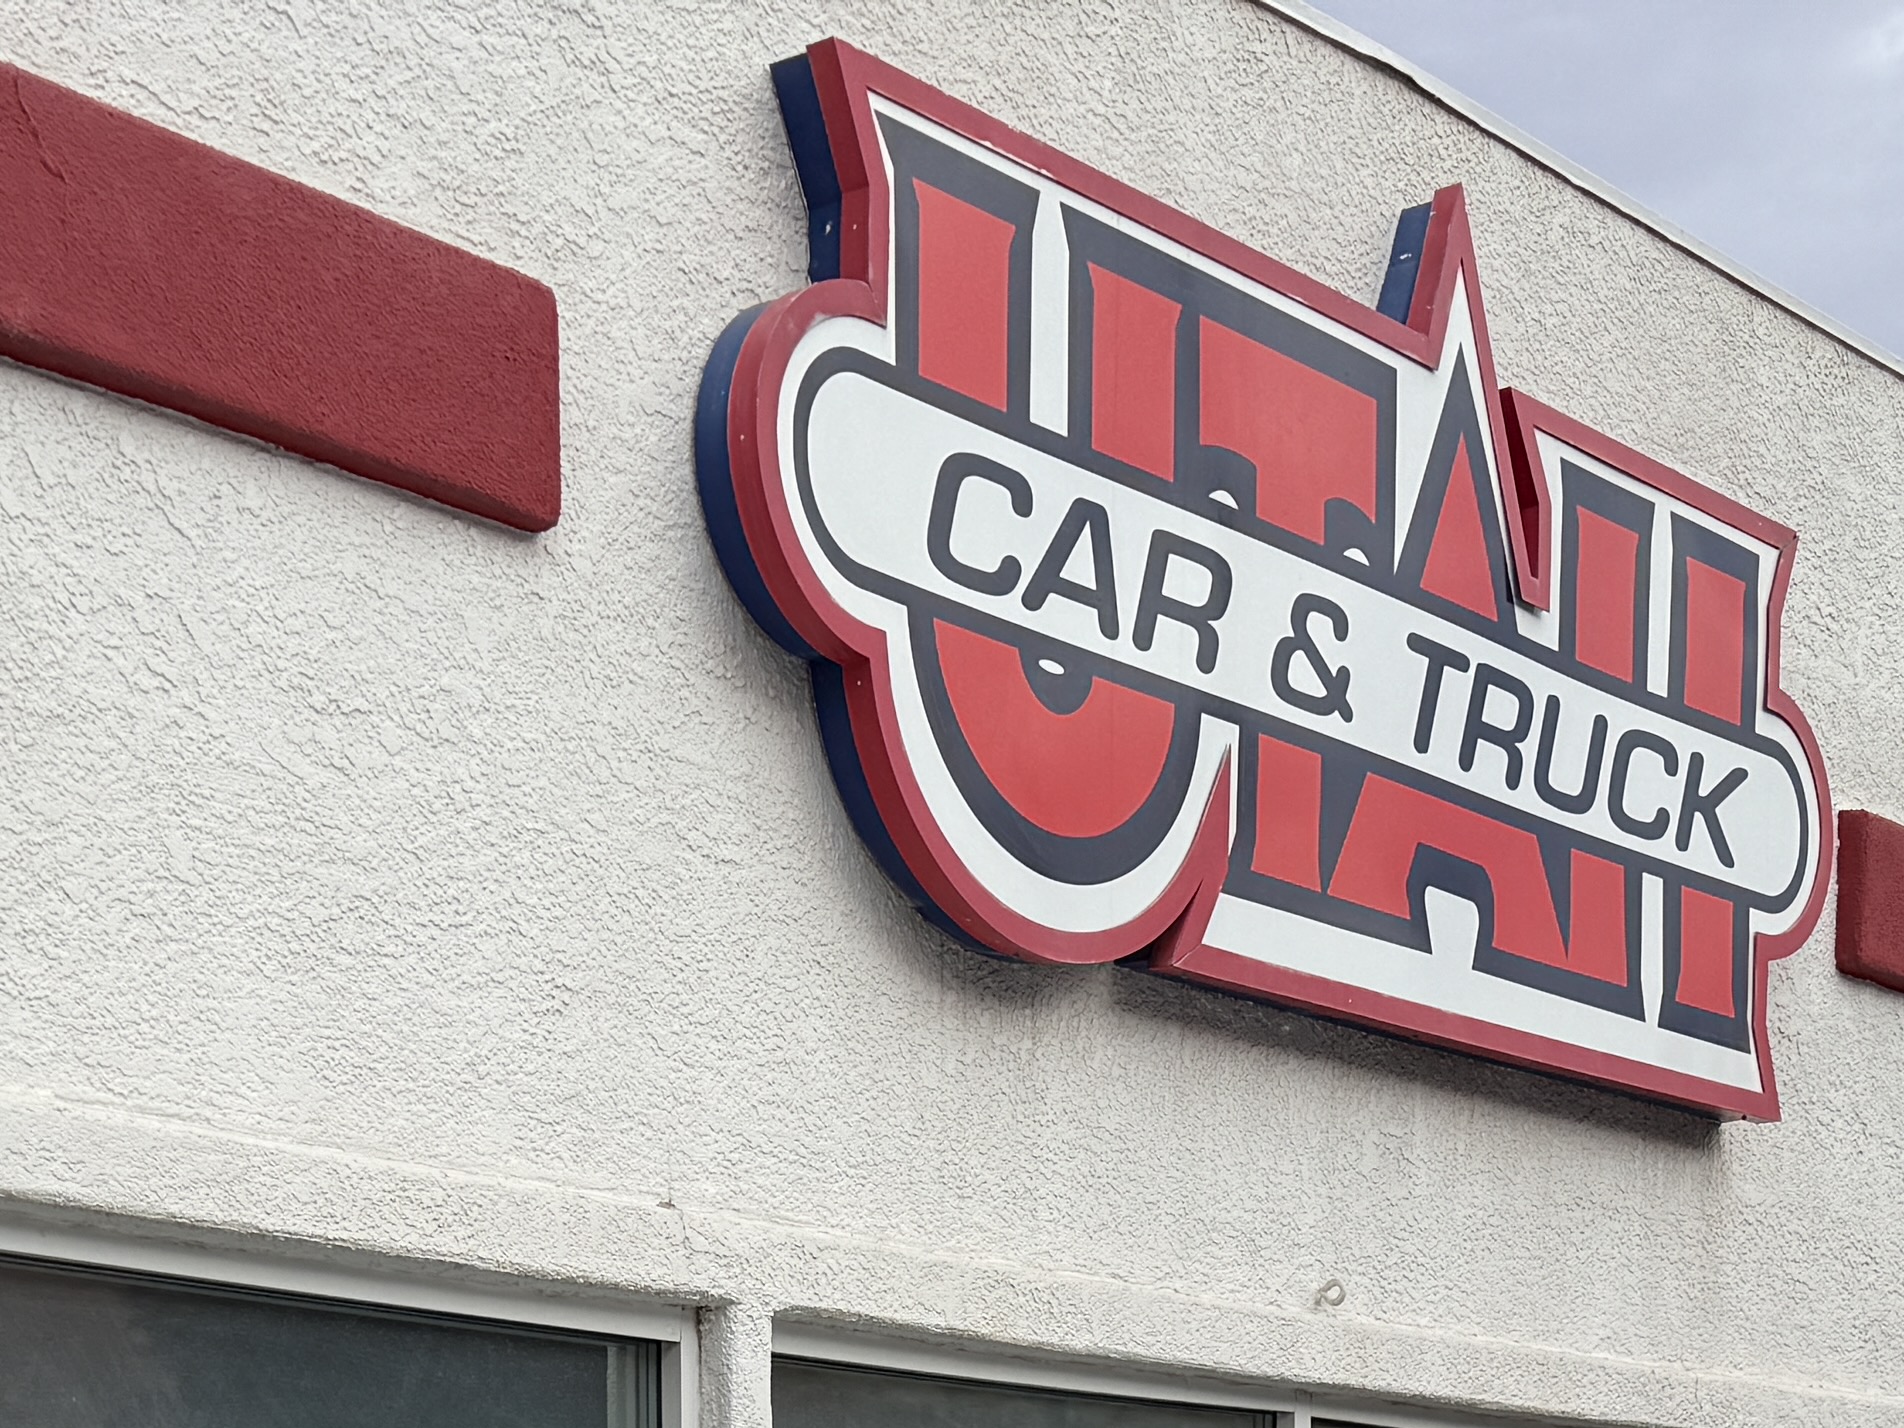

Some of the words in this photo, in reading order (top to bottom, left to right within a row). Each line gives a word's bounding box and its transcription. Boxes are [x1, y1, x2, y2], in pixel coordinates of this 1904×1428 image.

[874, 109, 1760, 1054] UTAH
[926, 452, 1234, 675] CAR
[1270, 591, 1355, 723] &
[1405, 630, 1750, 868] TRUCK
